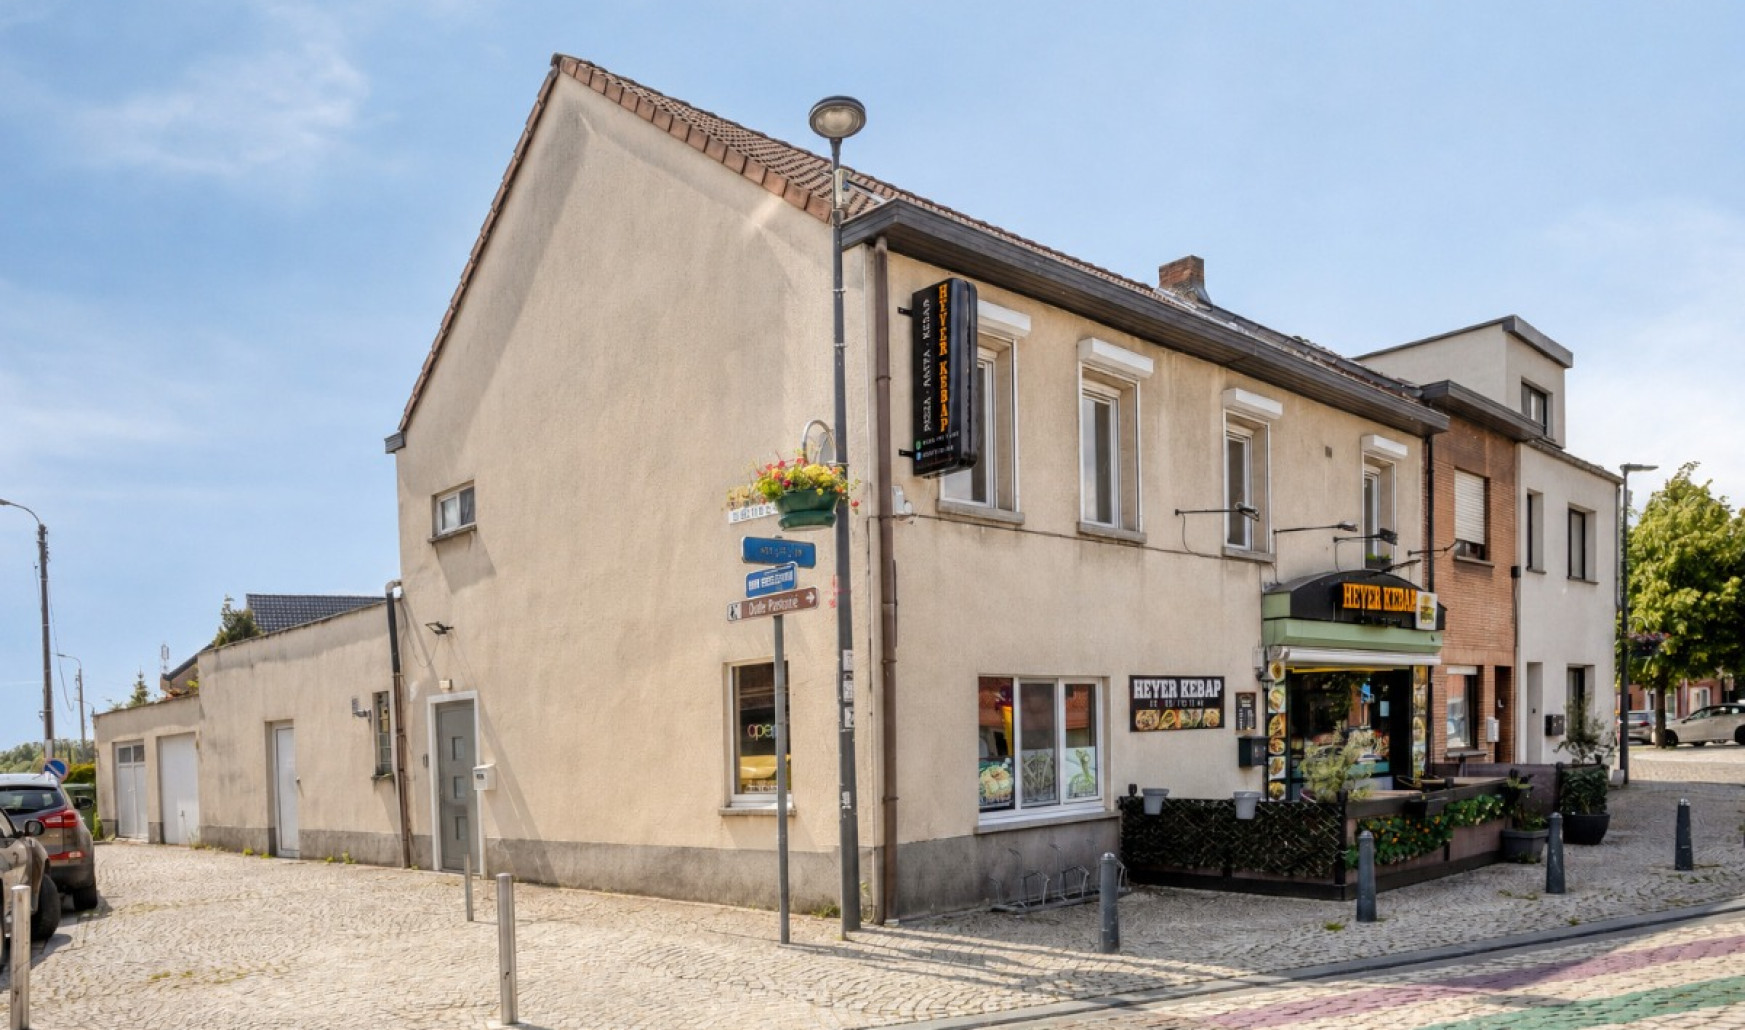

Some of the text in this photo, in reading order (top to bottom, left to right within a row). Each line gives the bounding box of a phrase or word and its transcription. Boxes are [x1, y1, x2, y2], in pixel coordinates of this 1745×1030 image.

[938, 284, 948, 433] HEYER KEBAP
[1343, 582, 1381, 611] HEYER
[1133, 679, 1222, 699] HEYER KEBAP
